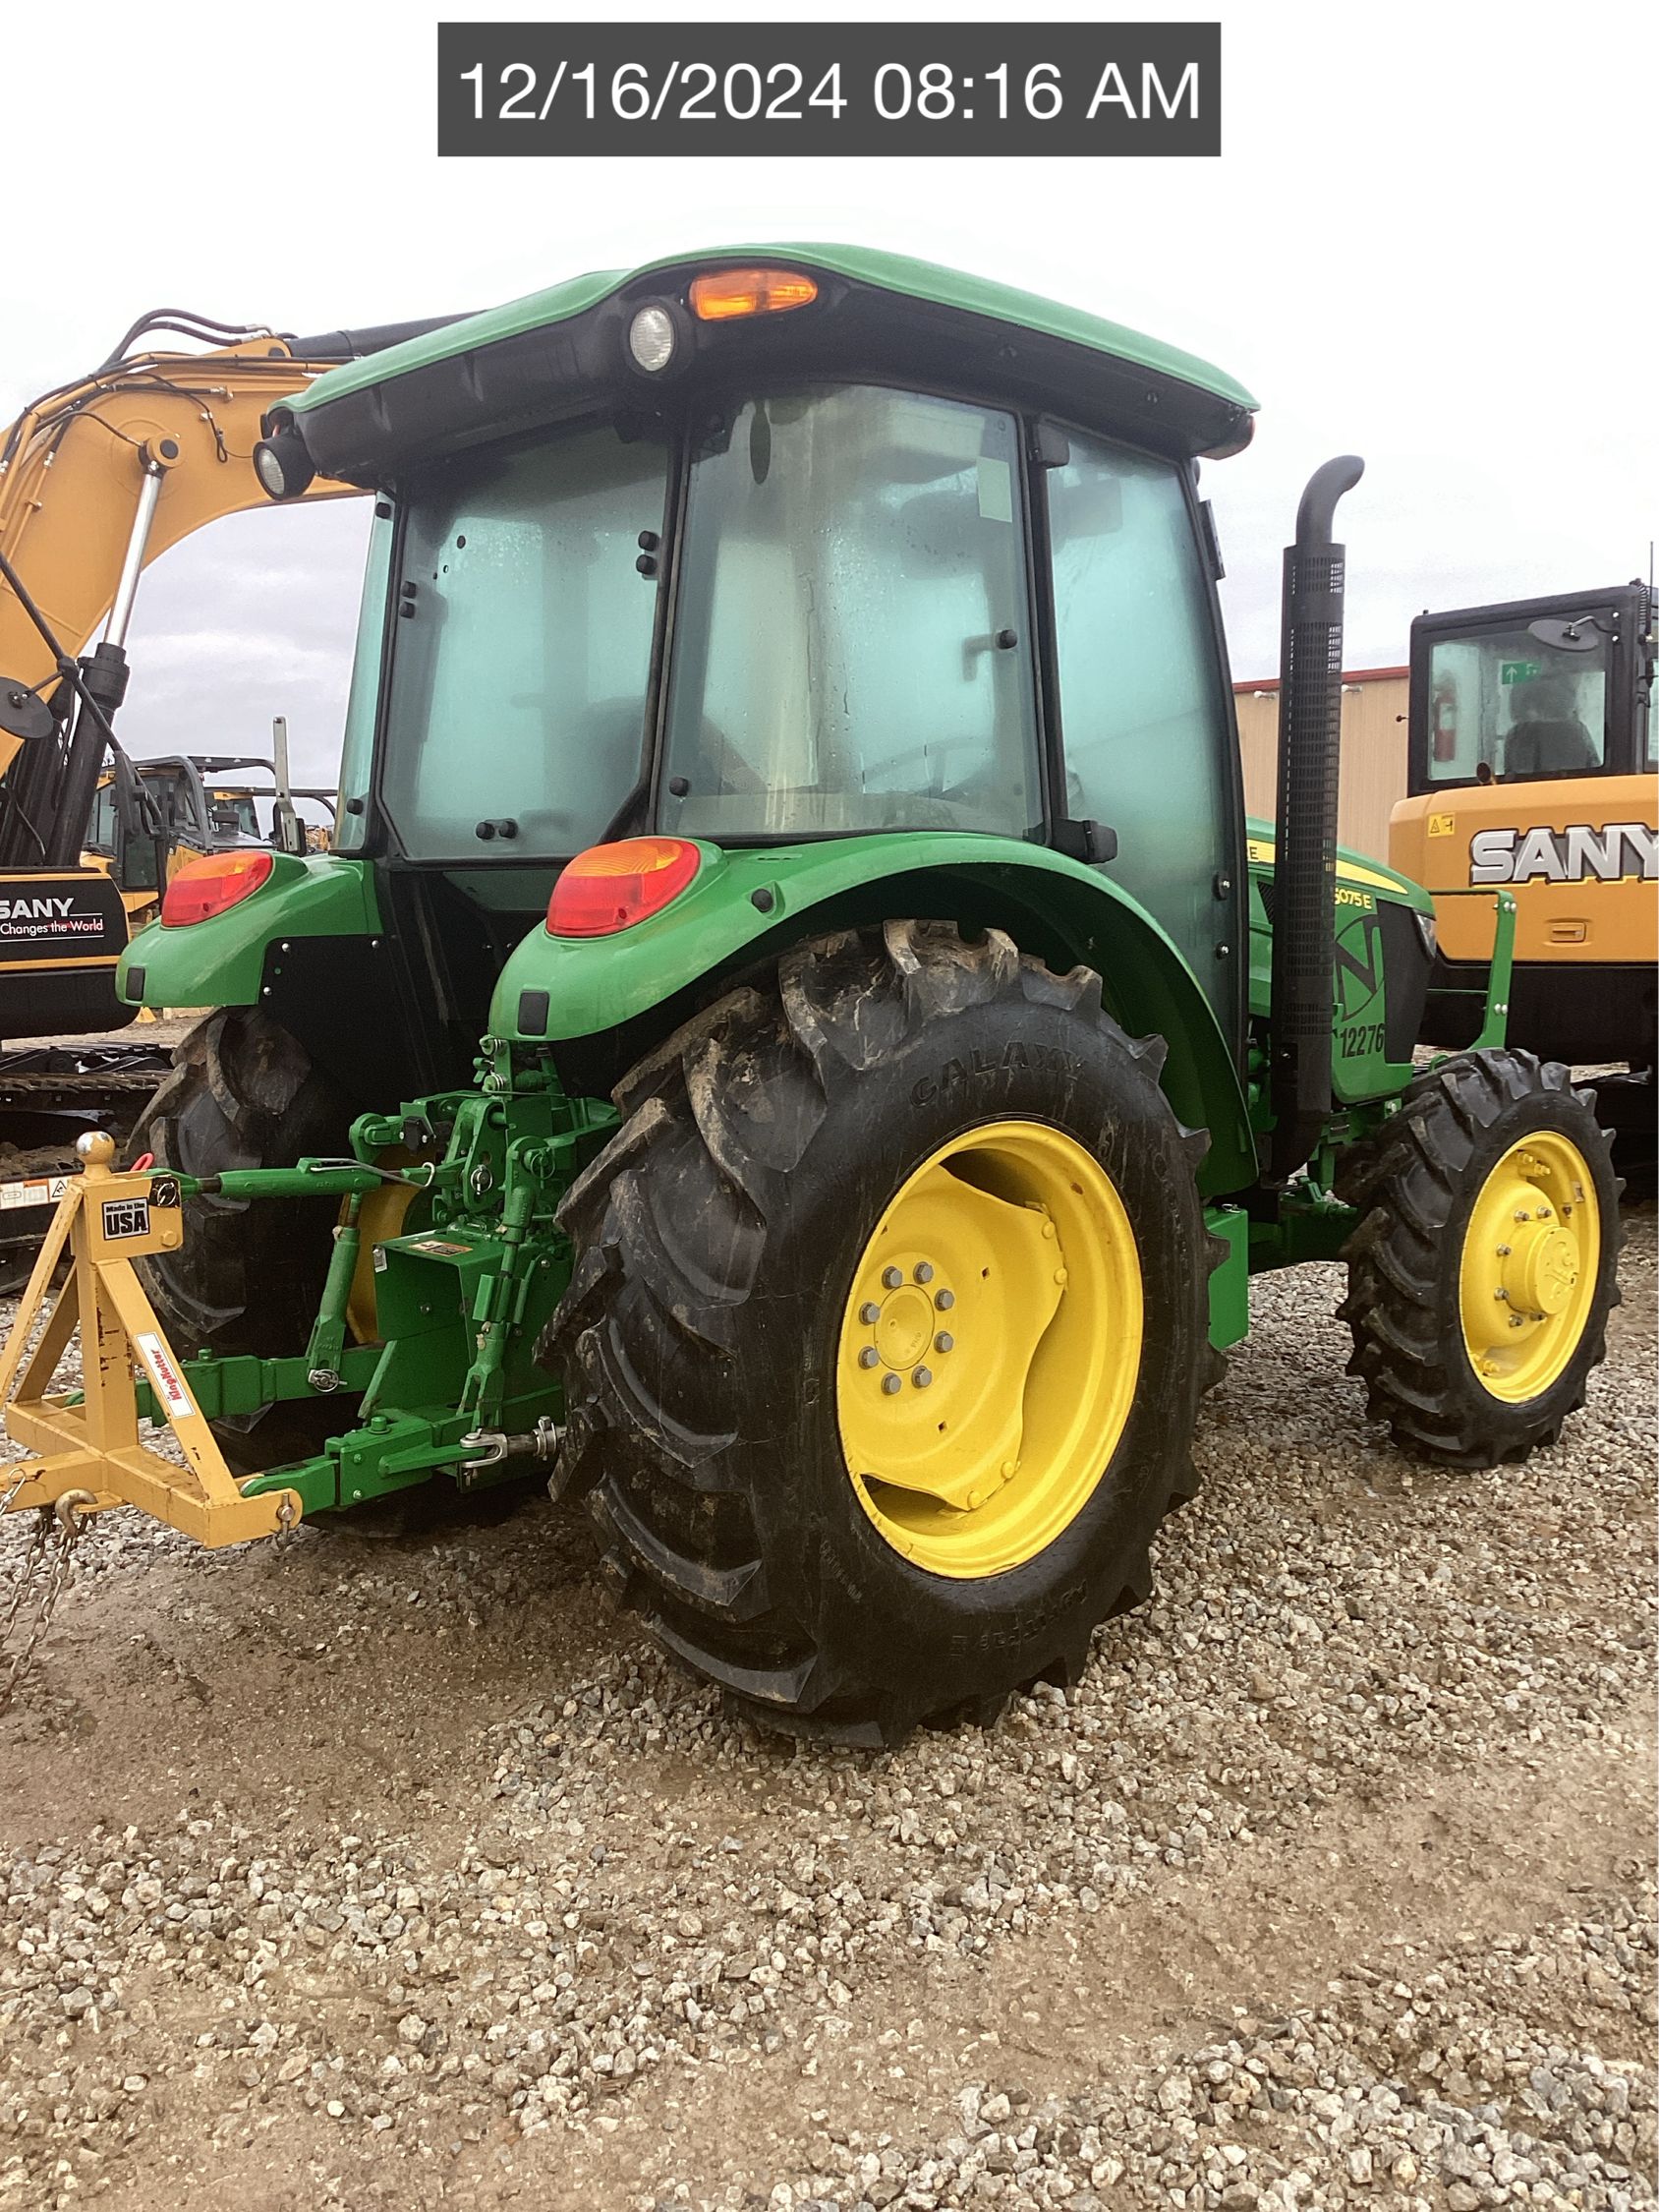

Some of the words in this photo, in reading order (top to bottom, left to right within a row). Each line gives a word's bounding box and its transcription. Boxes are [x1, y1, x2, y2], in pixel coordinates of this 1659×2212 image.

[1471, 825, 1659, 883] SANY
[0, 898, 74, 919] SANY
[0, 922, 48, 937] Changes
[51, 920, 68, 933] the
[70, 918, 103, 932] World
[105, 1210, 147, 1236] USA
